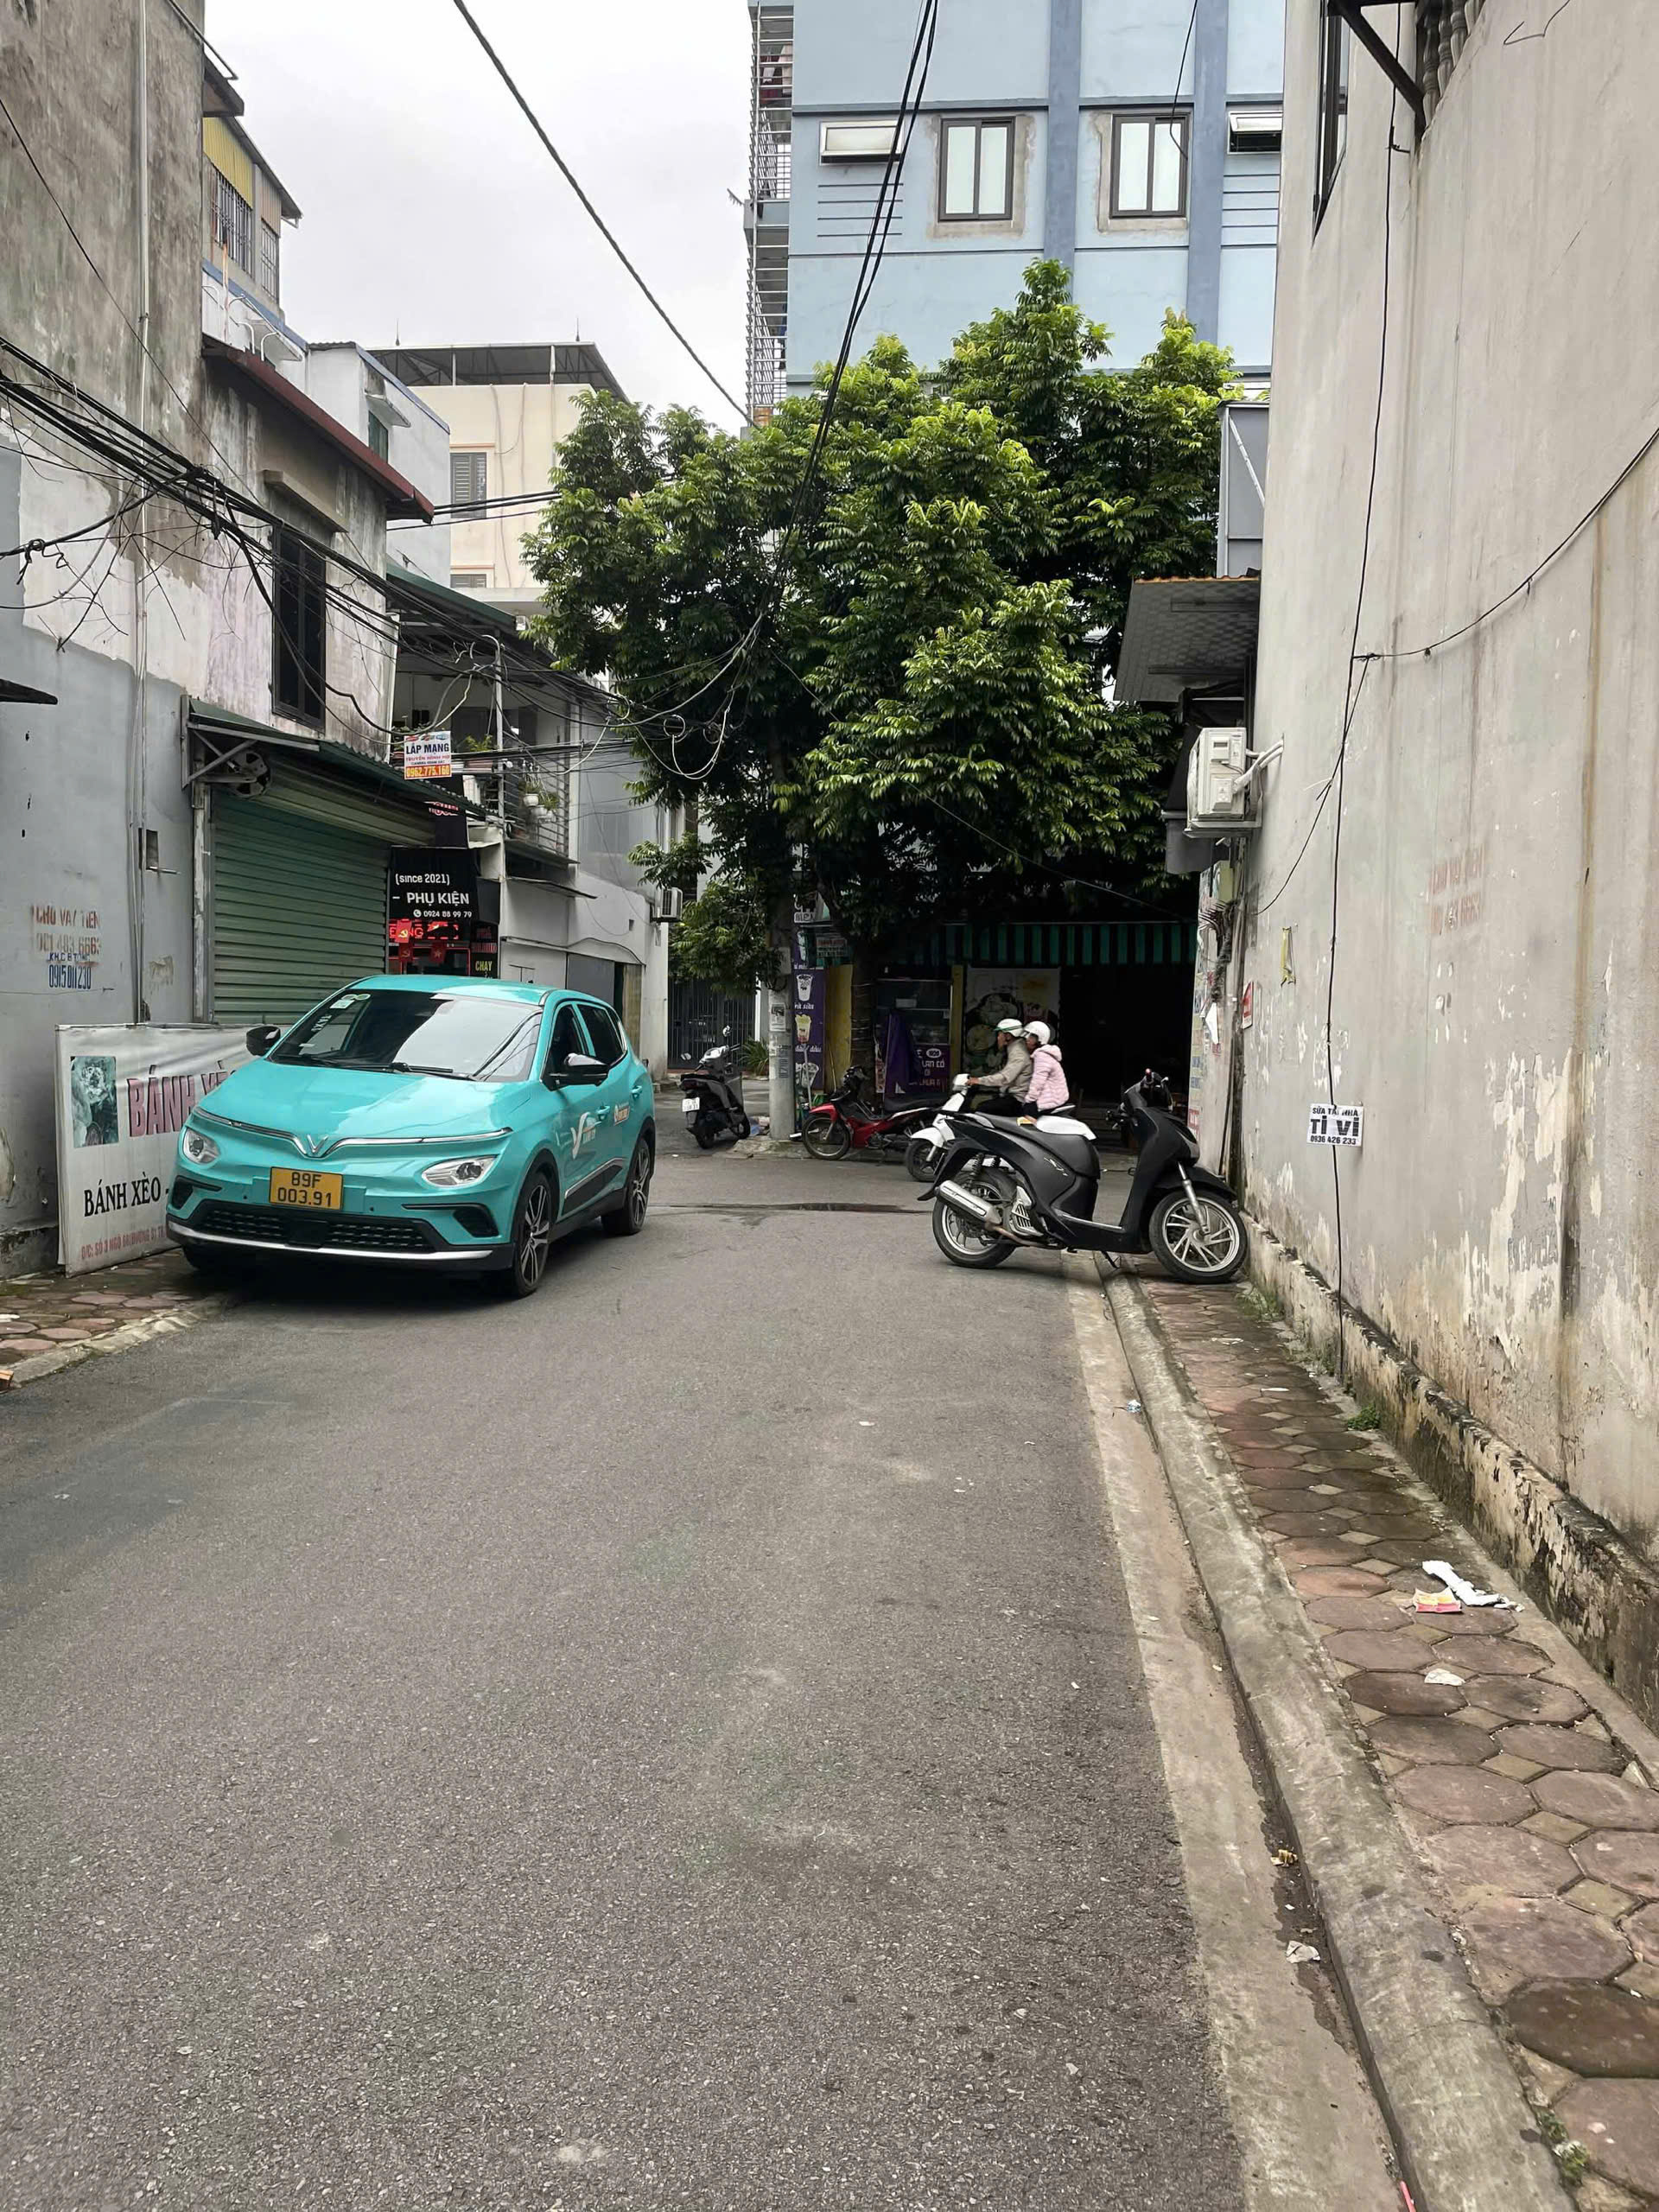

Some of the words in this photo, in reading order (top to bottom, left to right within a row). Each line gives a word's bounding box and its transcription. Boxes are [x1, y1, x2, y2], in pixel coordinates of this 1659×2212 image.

[424, 874, 450, 886] 2021)
[406, 892, 435, 906] PHỤ
[437, 891, 469, 906] KIỆN
[127, 1064, 196, 1137] BÁNH
[291, 1172, 322, 1189] 89F
[84, 1179, 128, 1217] BÁNH
[130, 1171, 162, 1207] XÈO
[277, 1187, 333, 1207] 003.91
